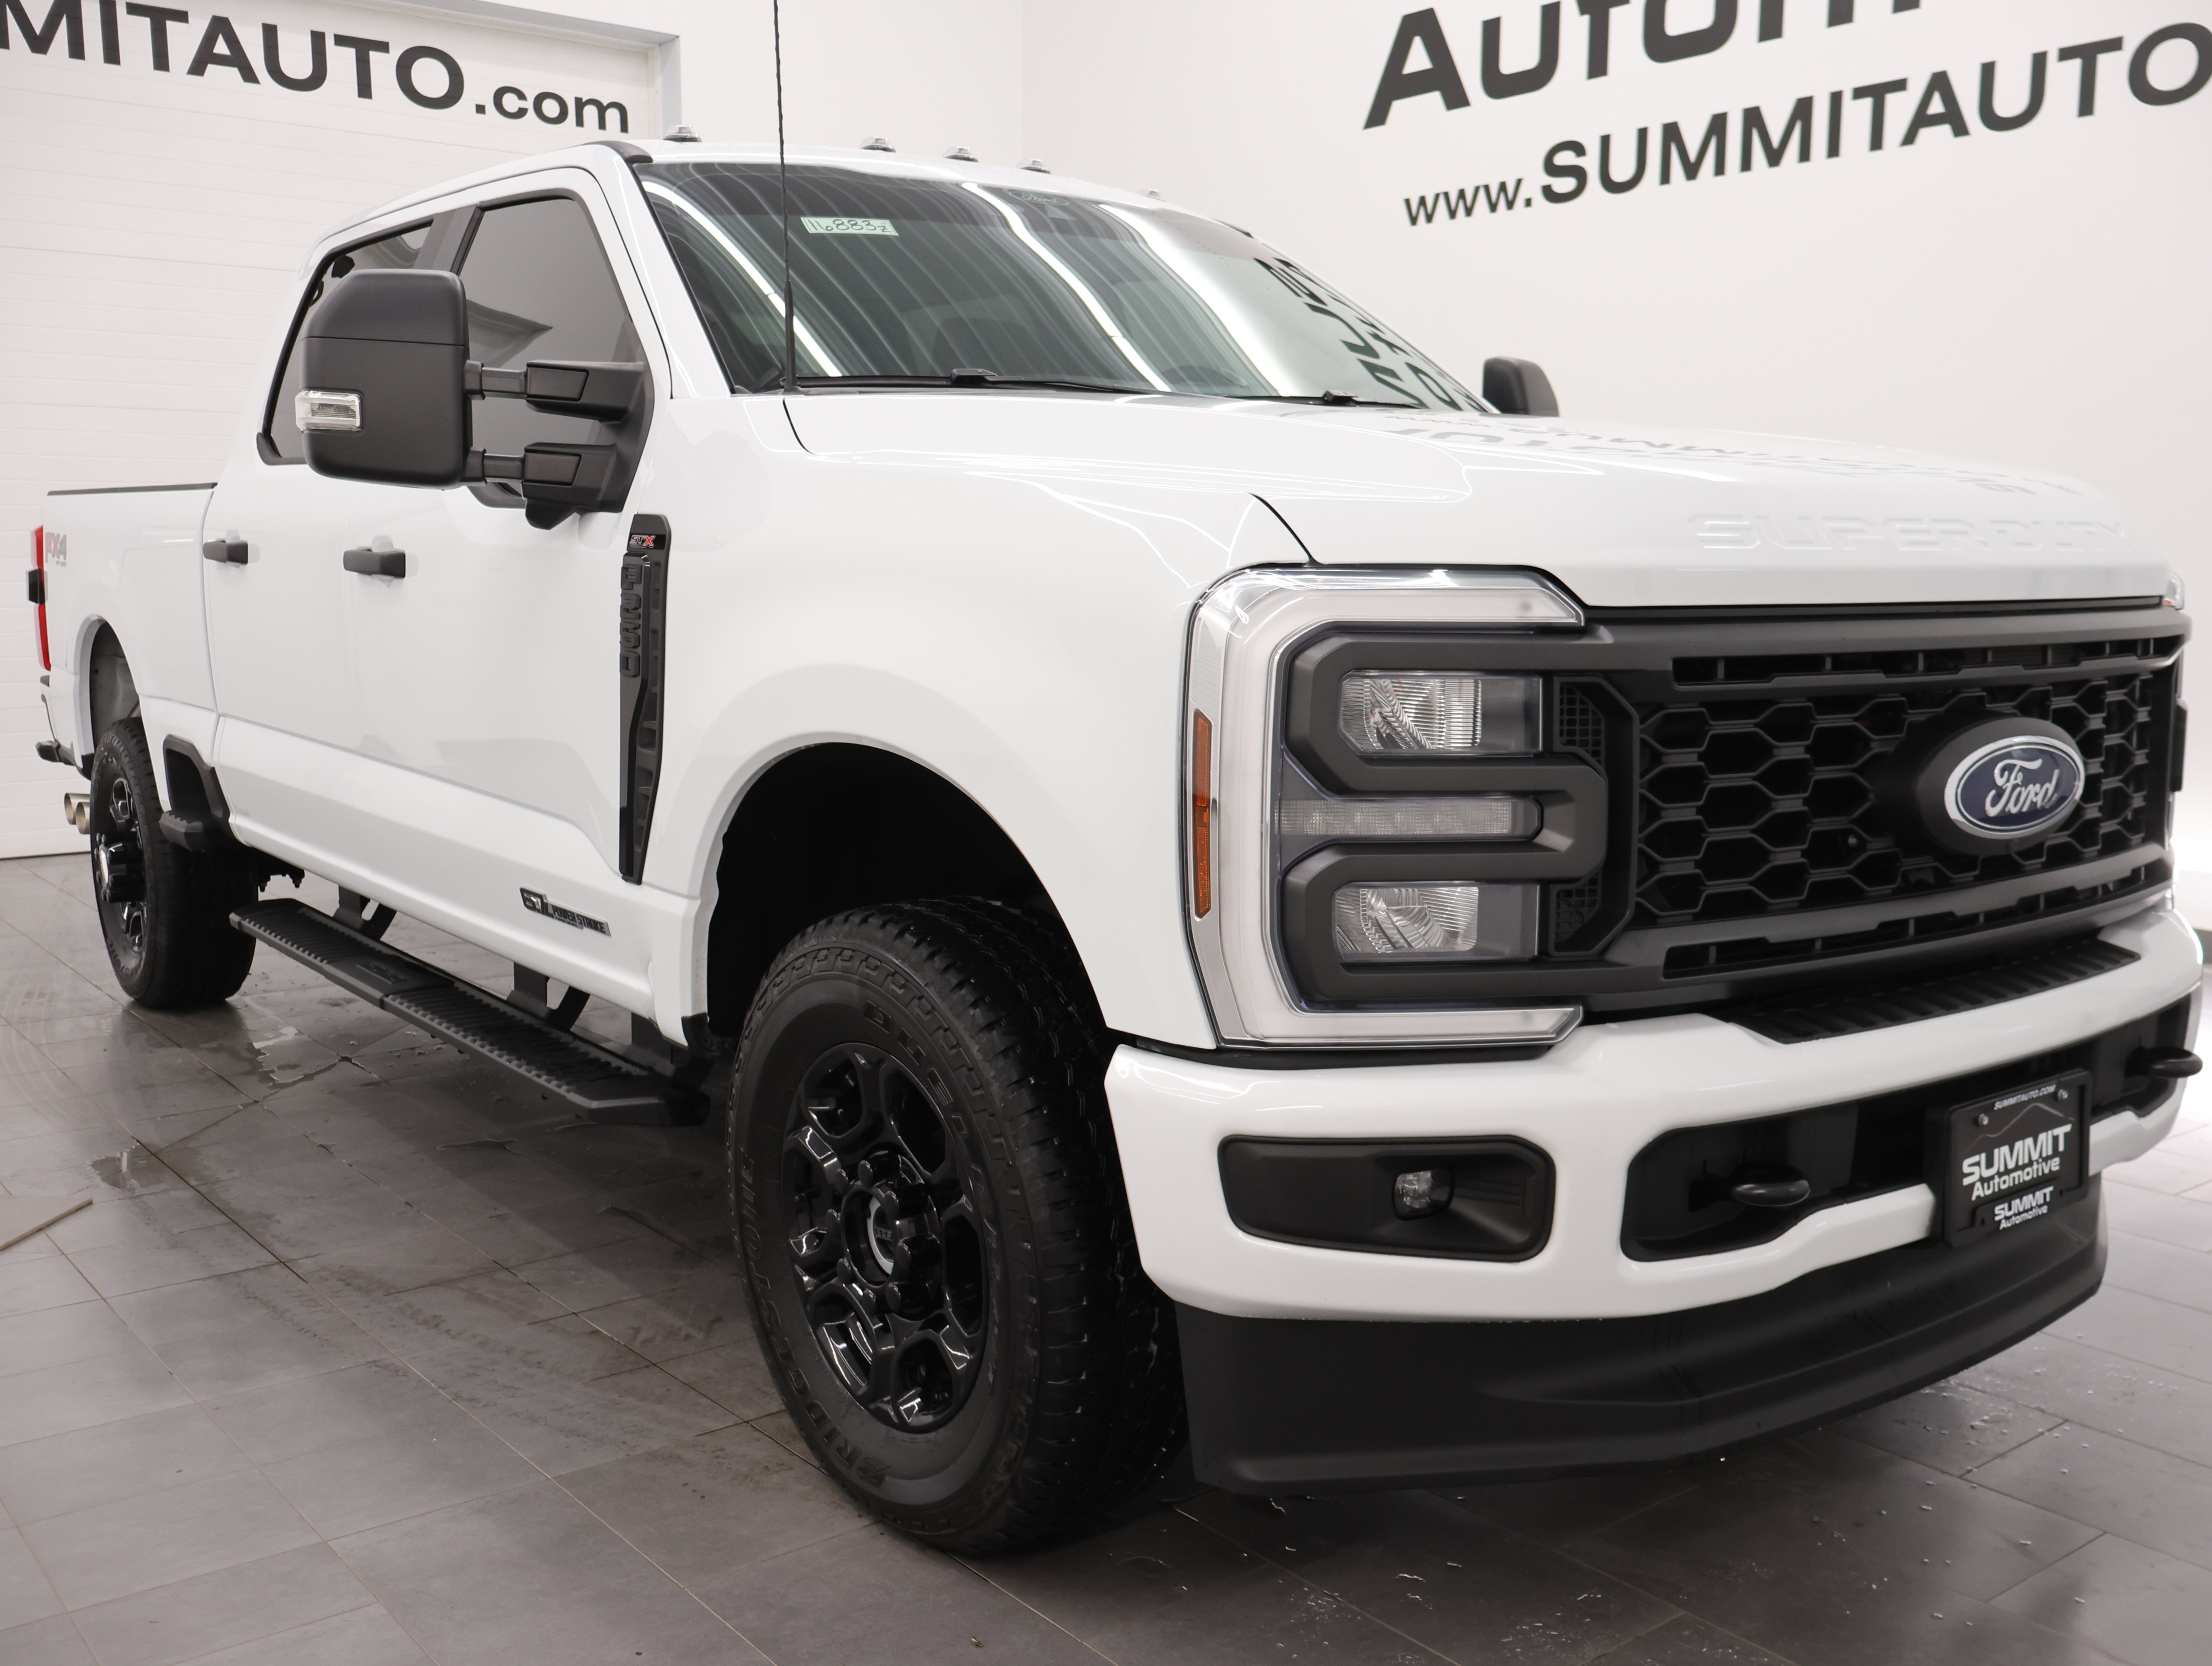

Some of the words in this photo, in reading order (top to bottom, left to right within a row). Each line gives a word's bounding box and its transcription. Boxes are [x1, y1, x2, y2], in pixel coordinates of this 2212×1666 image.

[629, 535, 655, 548] STX
[1984, 758, 2060, 818] Ford
[1962, 1123, 2072, 1186] SUMMIT
[1971, 1157, 2060, 1201] Automotive
[1994, 1186, 2054, 1221] SUMMIT
[1999, 1205, 2048, 1230] Automotive
